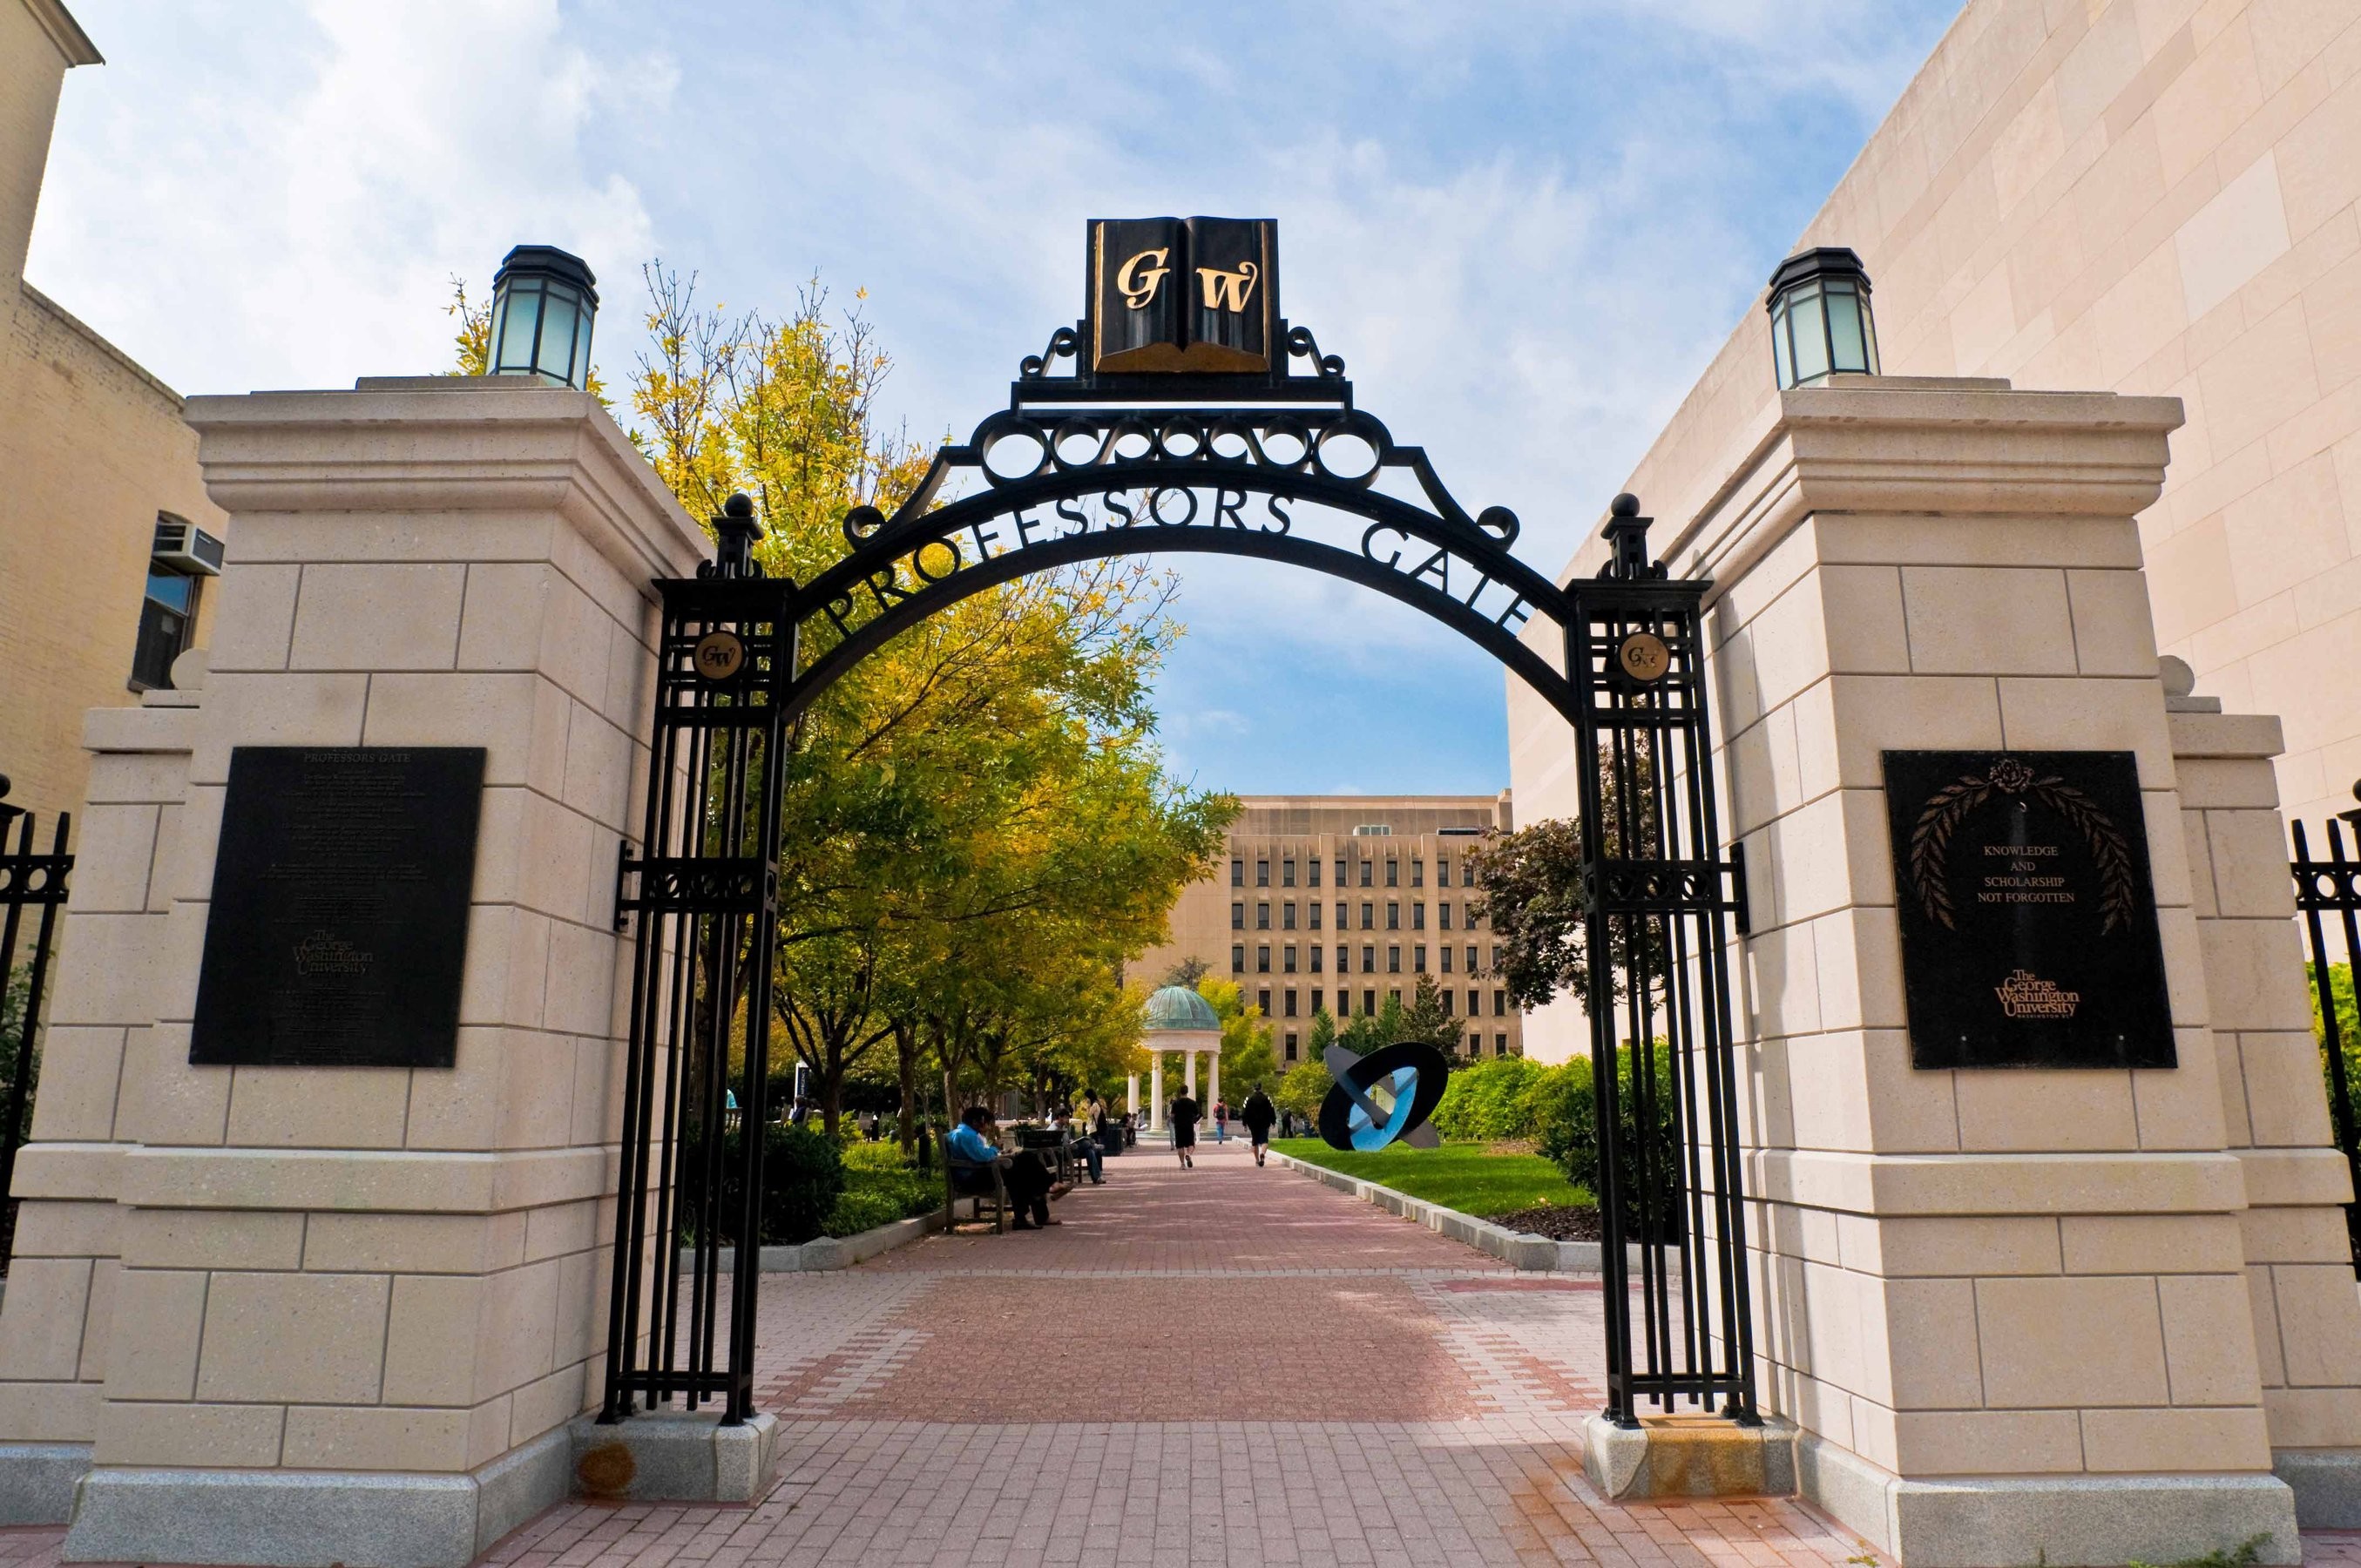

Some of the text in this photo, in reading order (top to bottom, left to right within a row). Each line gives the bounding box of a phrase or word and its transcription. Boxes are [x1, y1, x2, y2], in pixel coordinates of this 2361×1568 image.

[1117, 247, 1259, 313] G W
[822, 485, 1539, 639] PROFESSORS GATE
[702, 645, 736, 667] GW
[304, 753, 412, 764] PROFESSORS GATE
[1984, 846, 2059, 856] KNOWLEDGE
[2010, 862, 2036, 871] AND
[1985, 876, 2065, 887] SCHOLARSHIP
[1978, 892, 2075, 902] NOT FORGOTTEN
[314, 929, 335, 941] The
[302, 936, 354, 953] George
[293, 946, 375, 964] Washington
[298, 961, 368, 975] University
[2013, 970, 2035, 981] The
[2004, 977, 2057, 993] George
[1994, 987, 2080, 1005] Washington
[2004, 1001, 2076, 1017] University
